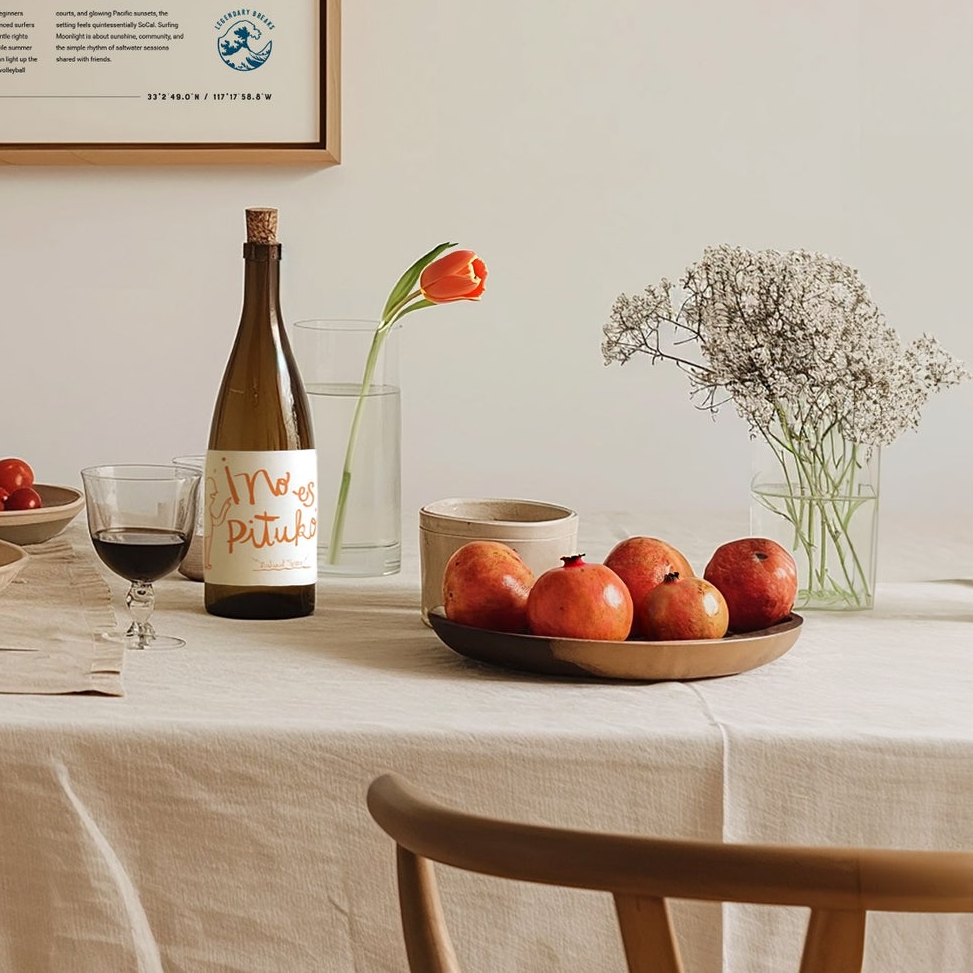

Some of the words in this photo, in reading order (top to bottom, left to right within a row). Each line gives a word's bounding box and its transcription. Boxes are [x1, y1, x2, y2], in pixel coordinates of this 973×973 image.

[56, 10, 76, 18] courts,
[89, 10, 111, 18] glowing
[134, 10, 157, 18] sunsets,
[214, 9, 250, 30] LEGENDARY
[252, 11, 275, 30] BREAKS
[56, 33, 84, 41] Moonlight
[110, 33, 137, 41] sunshine,
[139, 33, 172, 41] community,
[67, 44, 86, 52] simple
[87, 44, 107, 52] rhythm
